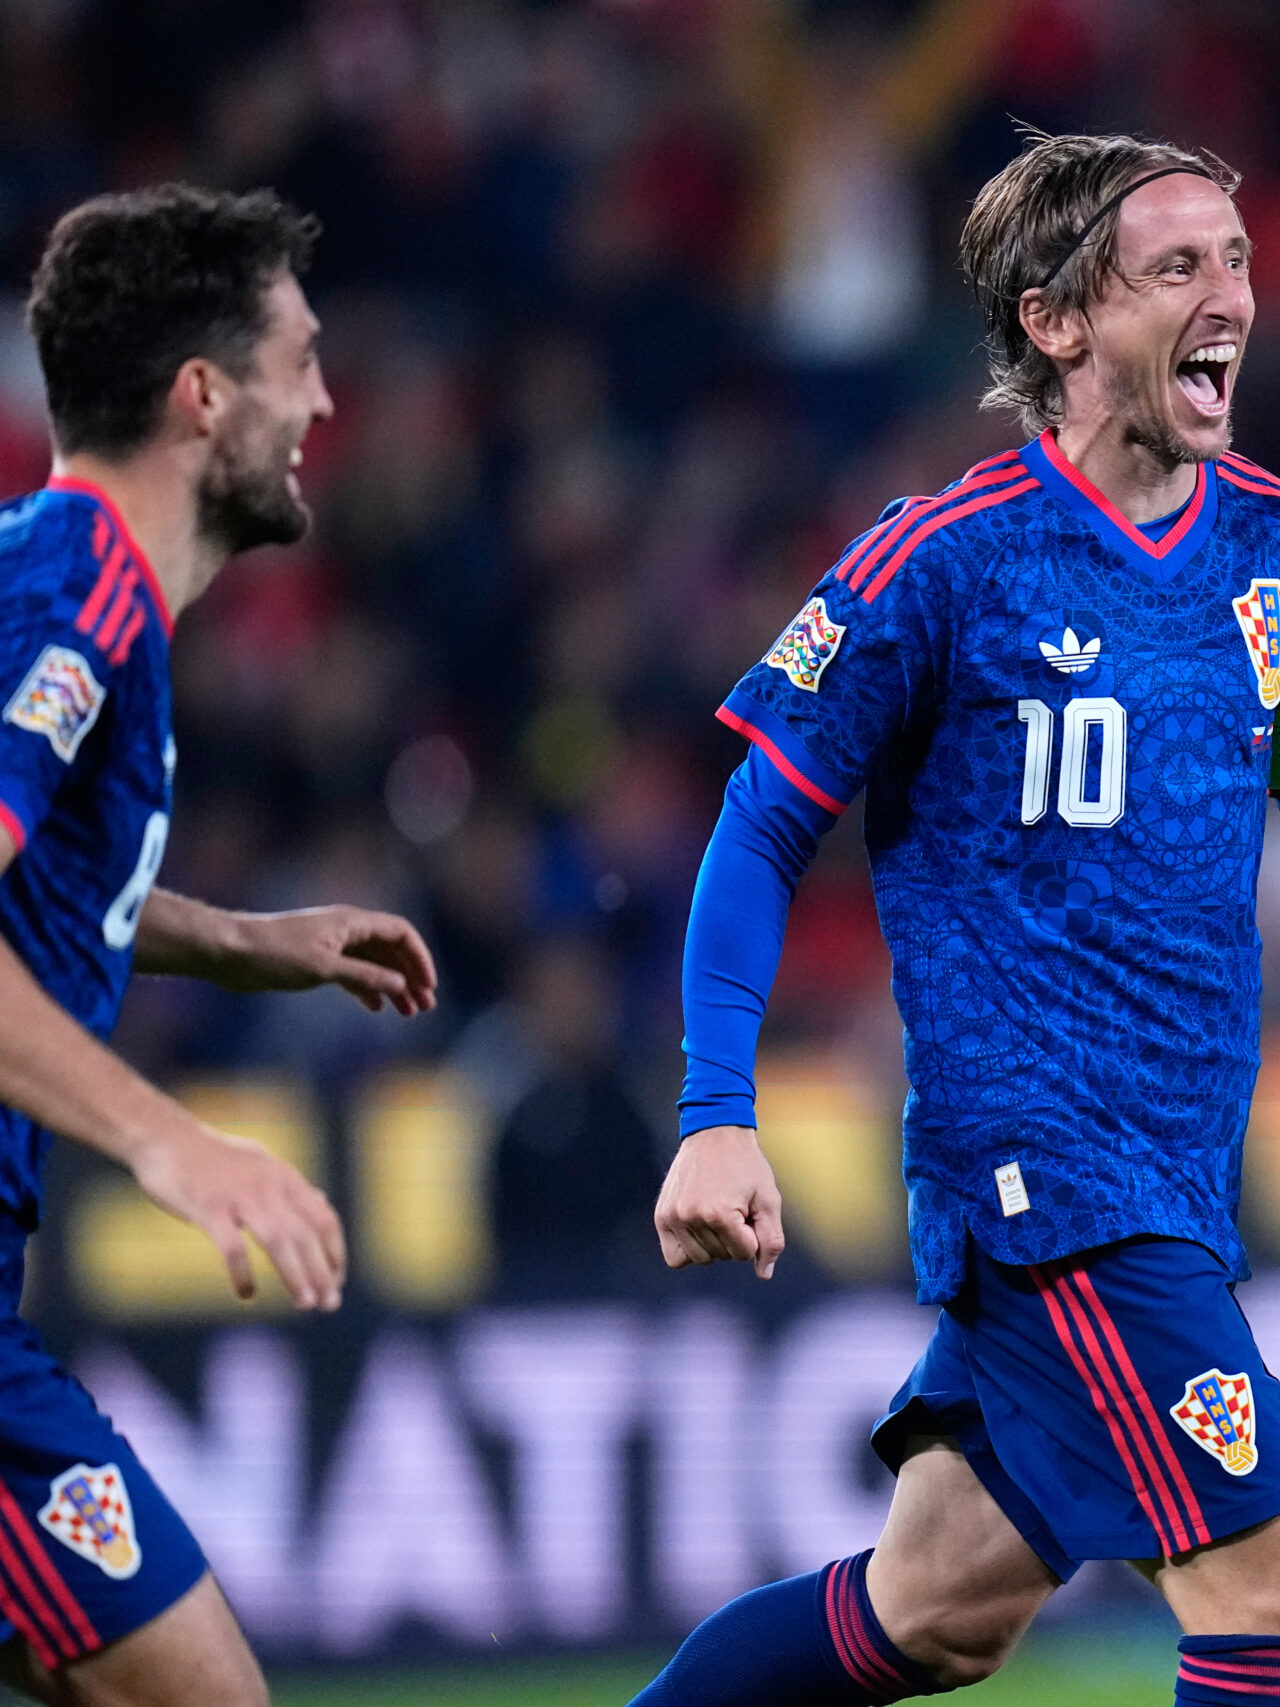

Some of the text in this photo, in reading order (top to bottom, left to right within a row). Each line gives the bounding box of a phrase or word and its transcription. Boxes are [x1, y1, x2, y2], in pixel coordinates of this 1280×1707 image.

[1263, 593, 1279, 656] HNS
[1017, 697, 1127, 828] 10
[1201, 1384, 1232, 1435] HNS
